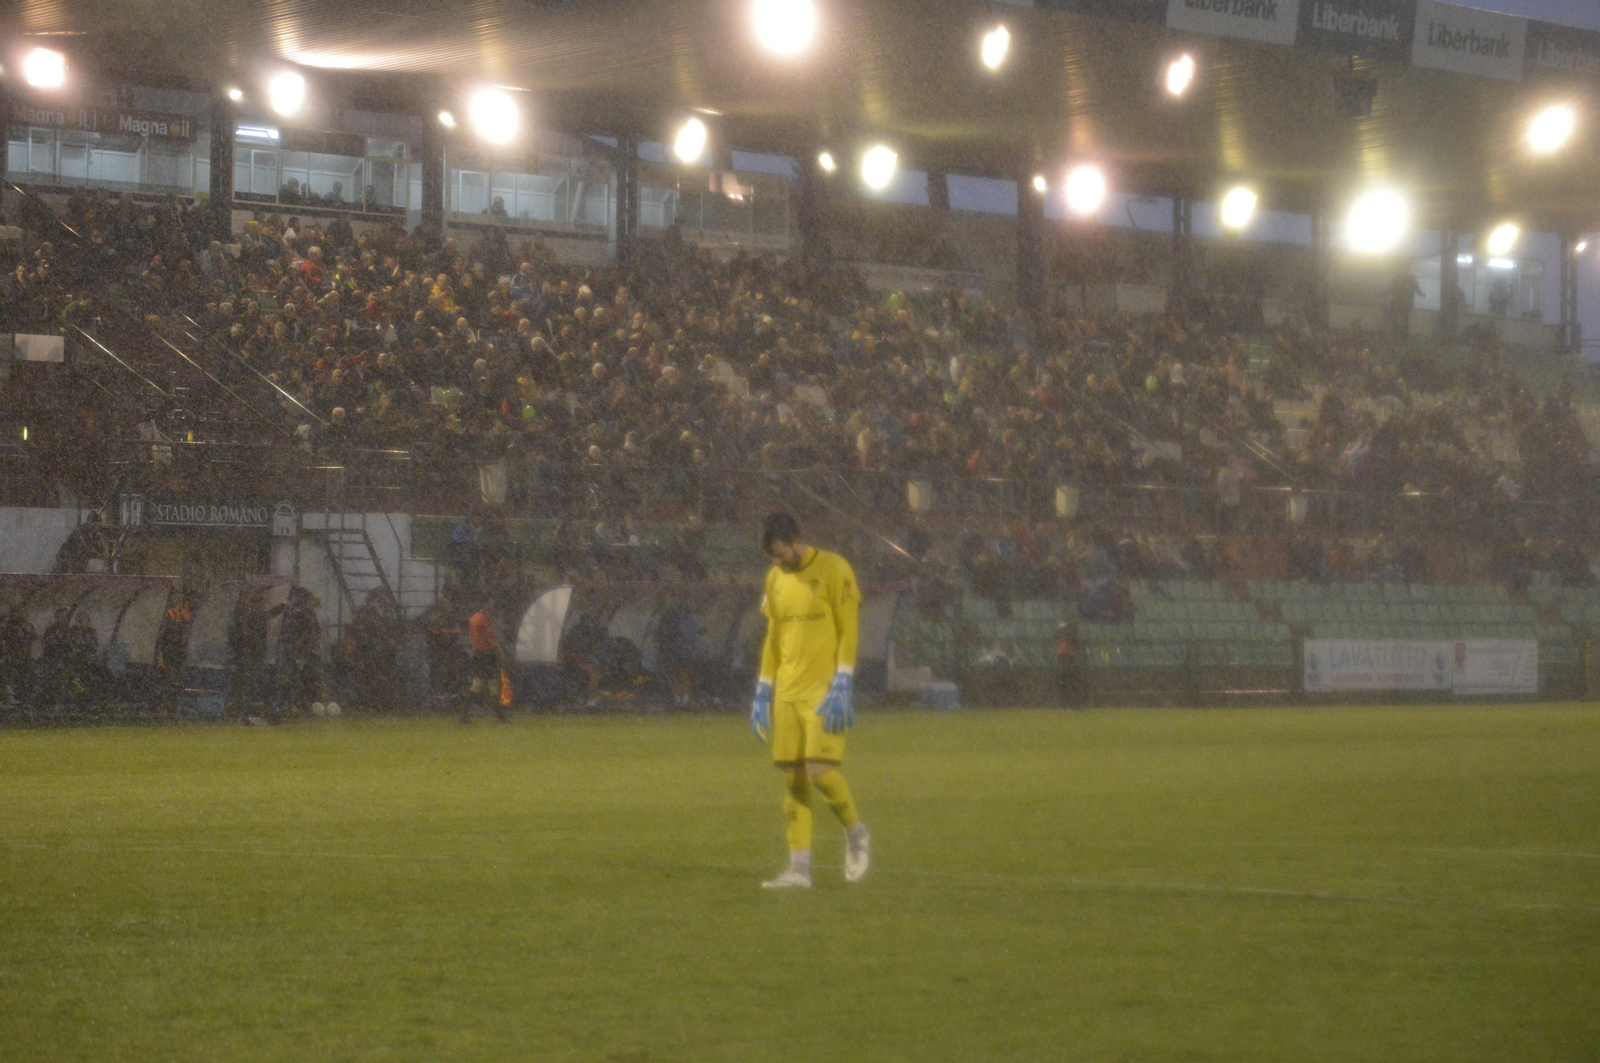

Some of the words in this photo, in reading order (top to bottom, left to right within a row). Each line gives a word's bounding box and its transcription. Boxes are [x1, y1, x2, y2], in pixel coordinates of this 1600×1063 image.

[1312, 2, 1400, 40] Liberbank
[1428, 21, 1510, 57] Liberbank
[119, 115, 168, 137] Magna
[210, 505, 268, 523] ROMANO
